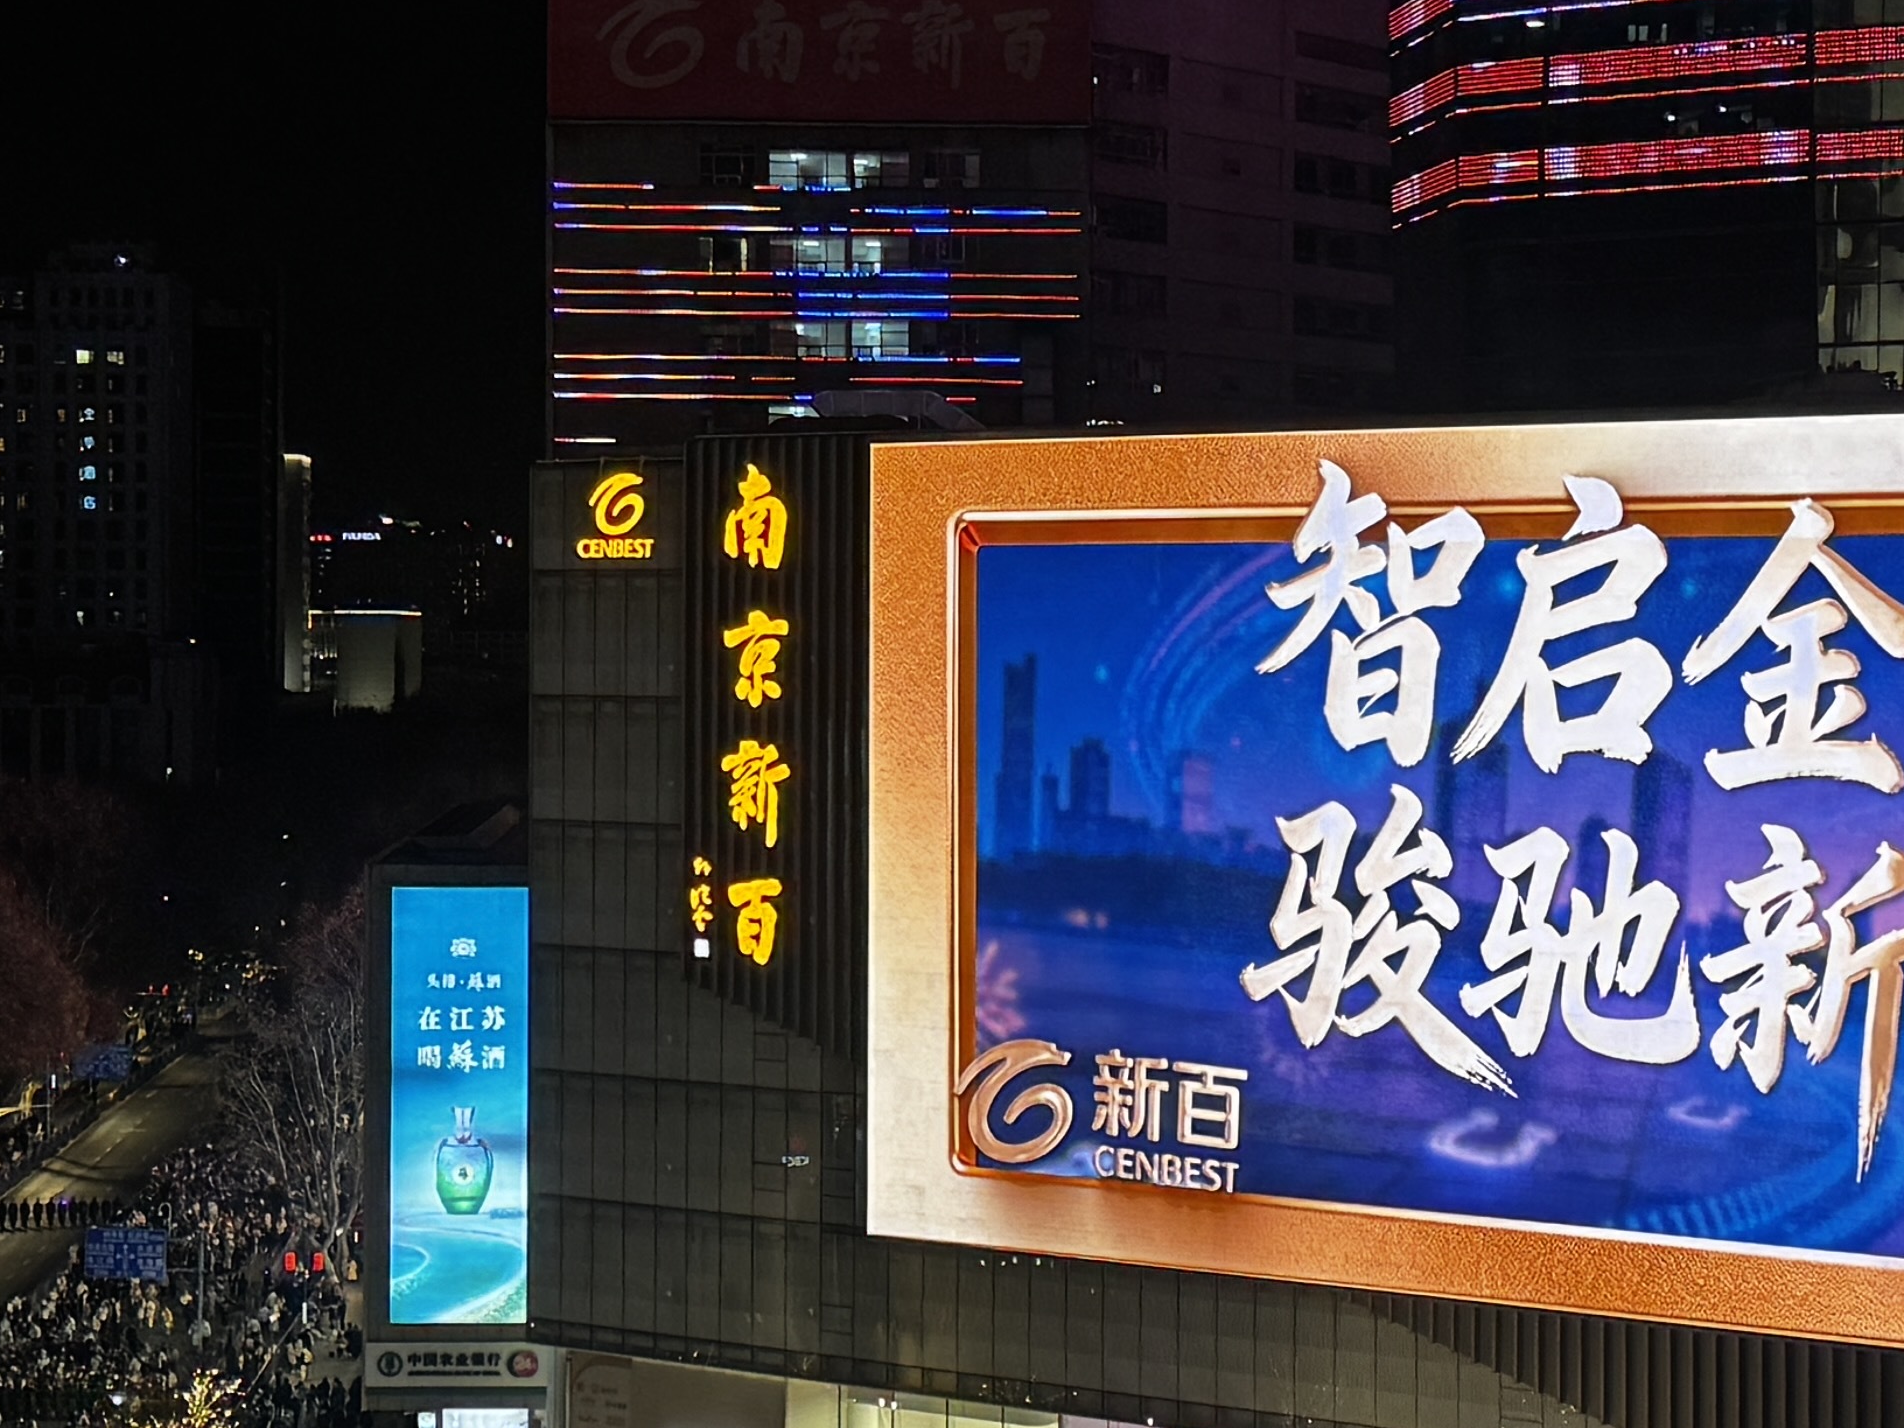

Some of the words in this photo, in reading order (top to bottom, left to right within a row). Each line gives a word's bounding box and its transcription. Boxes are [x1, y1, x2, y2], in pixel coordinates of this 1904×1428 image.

[577, 538, 655, 559] CENBEST
[721, 464, 790, 966] 南京新百
[417, 1005, 506, 1032] 在江苏
[1092, 1049, 1248, 1149] 新百
[1095, 1145, 1239, 1193] CENBEST
[407, 1351, 501, 1368] 中国农业银行
